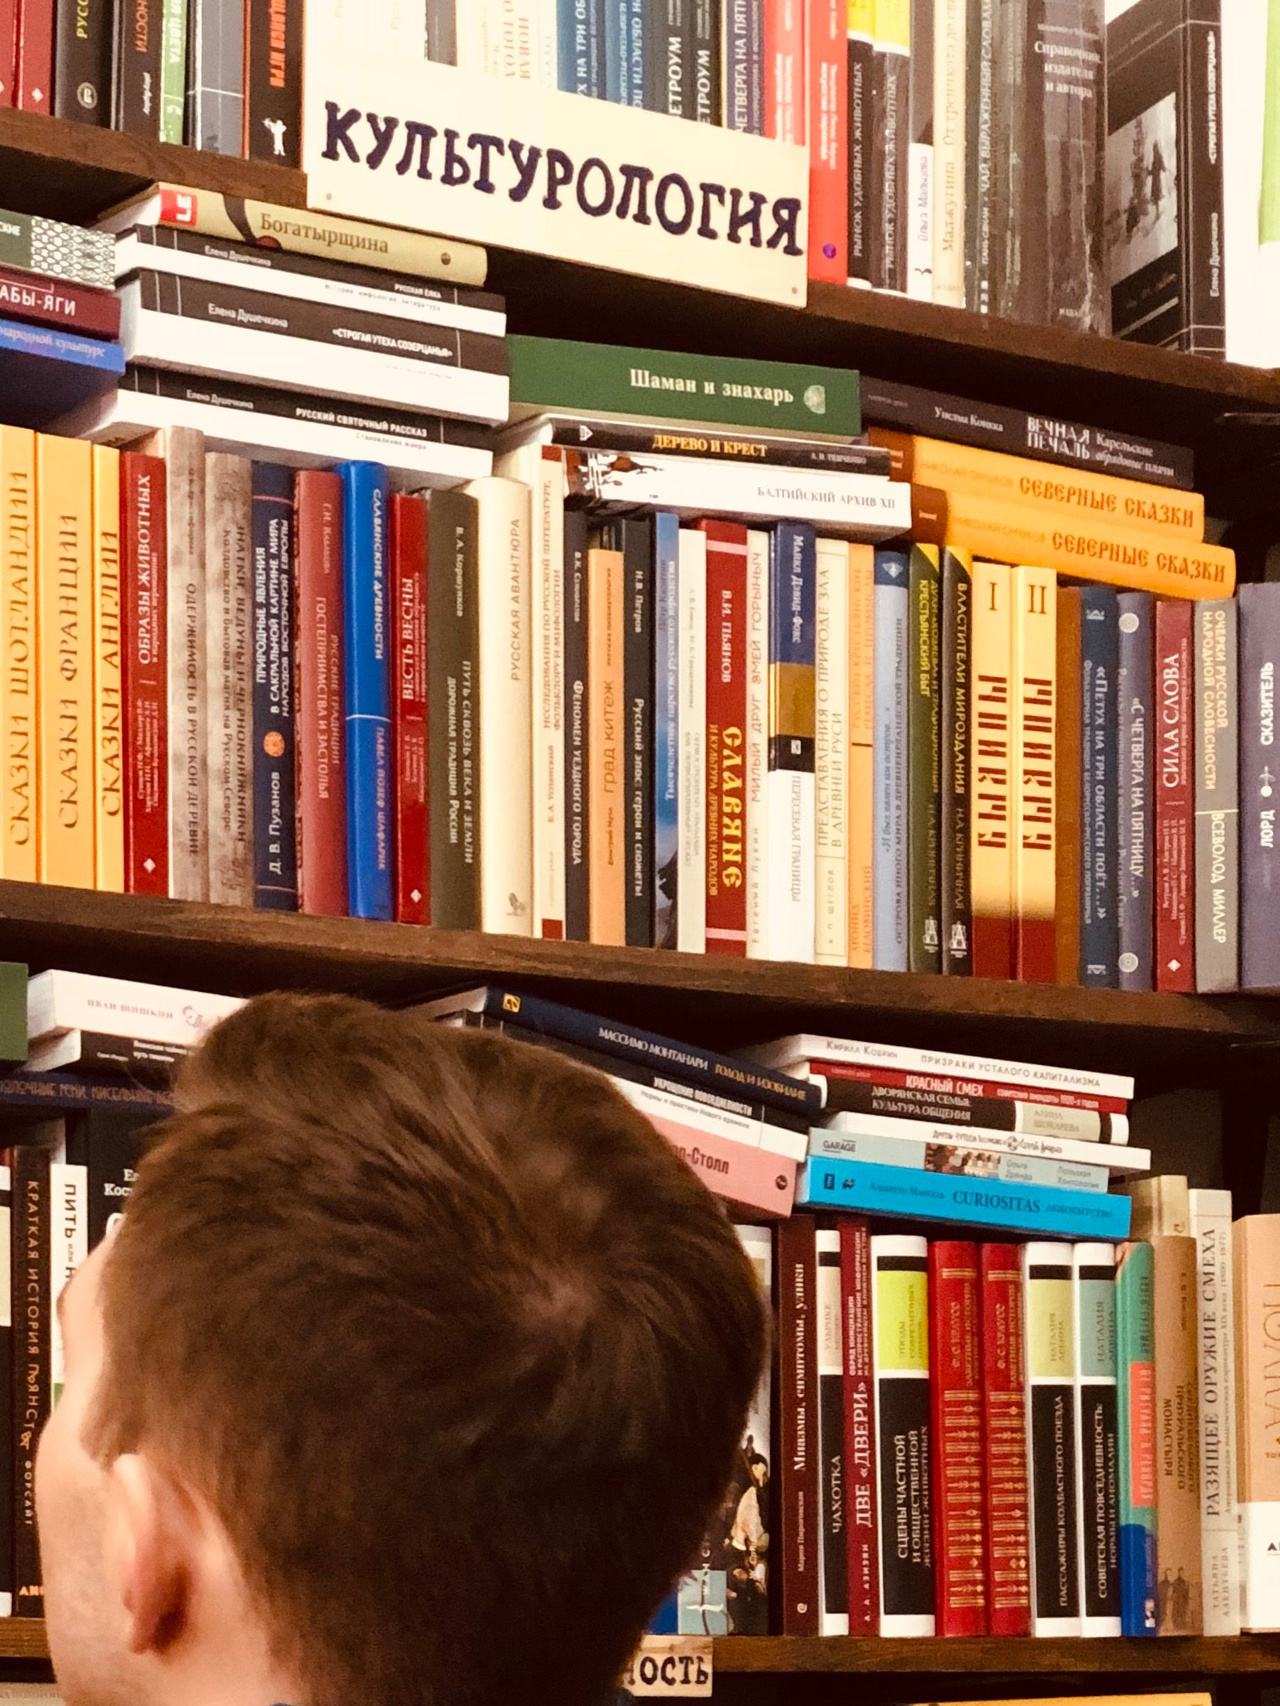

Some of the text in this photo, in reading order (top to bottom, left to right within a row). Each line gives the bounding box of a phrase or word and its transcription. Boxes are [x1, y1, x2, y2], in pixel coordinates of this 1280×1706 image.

[321, 99, 803, 256] КУЛЬТУРОЛОГИЯ
[260, 212, 389, 255] Богатырщина
[296, 407, 427, 438] РУССКИЙ СВЯТОЧНЫЙ РАССКАЗ
[629, 368, 795, 406] Шаман и знахарь
[652, 433, 768, 458] ДЕРЕВО И КРЕСТ
[137, 474, 152, 665] ОБРАЗЫ ЖИВОТНЫХ
[372, 487, 384, 660] СЛАВЯНСКИЕ ДРЕВНОСТИ
[1051, 531, 1227, 584] СЕВЕРНЫЕ СКАЗКИ
[9, 471, 29, 847] СКАЗКИ ШОТЛАНДИИ
[57, 514, 79, 829] СКАЗКИ ФРАНЦИИ
[1163, 653, 1179, 788] СИЛА СЛОВА
[722, 726, 742, 888] СЛАВЯНЕ
[906, 1075, 983, 1097] КРАСНЫЙ СМЕХ
[953, 1190, 1041, 1213] CURIOSITAS
